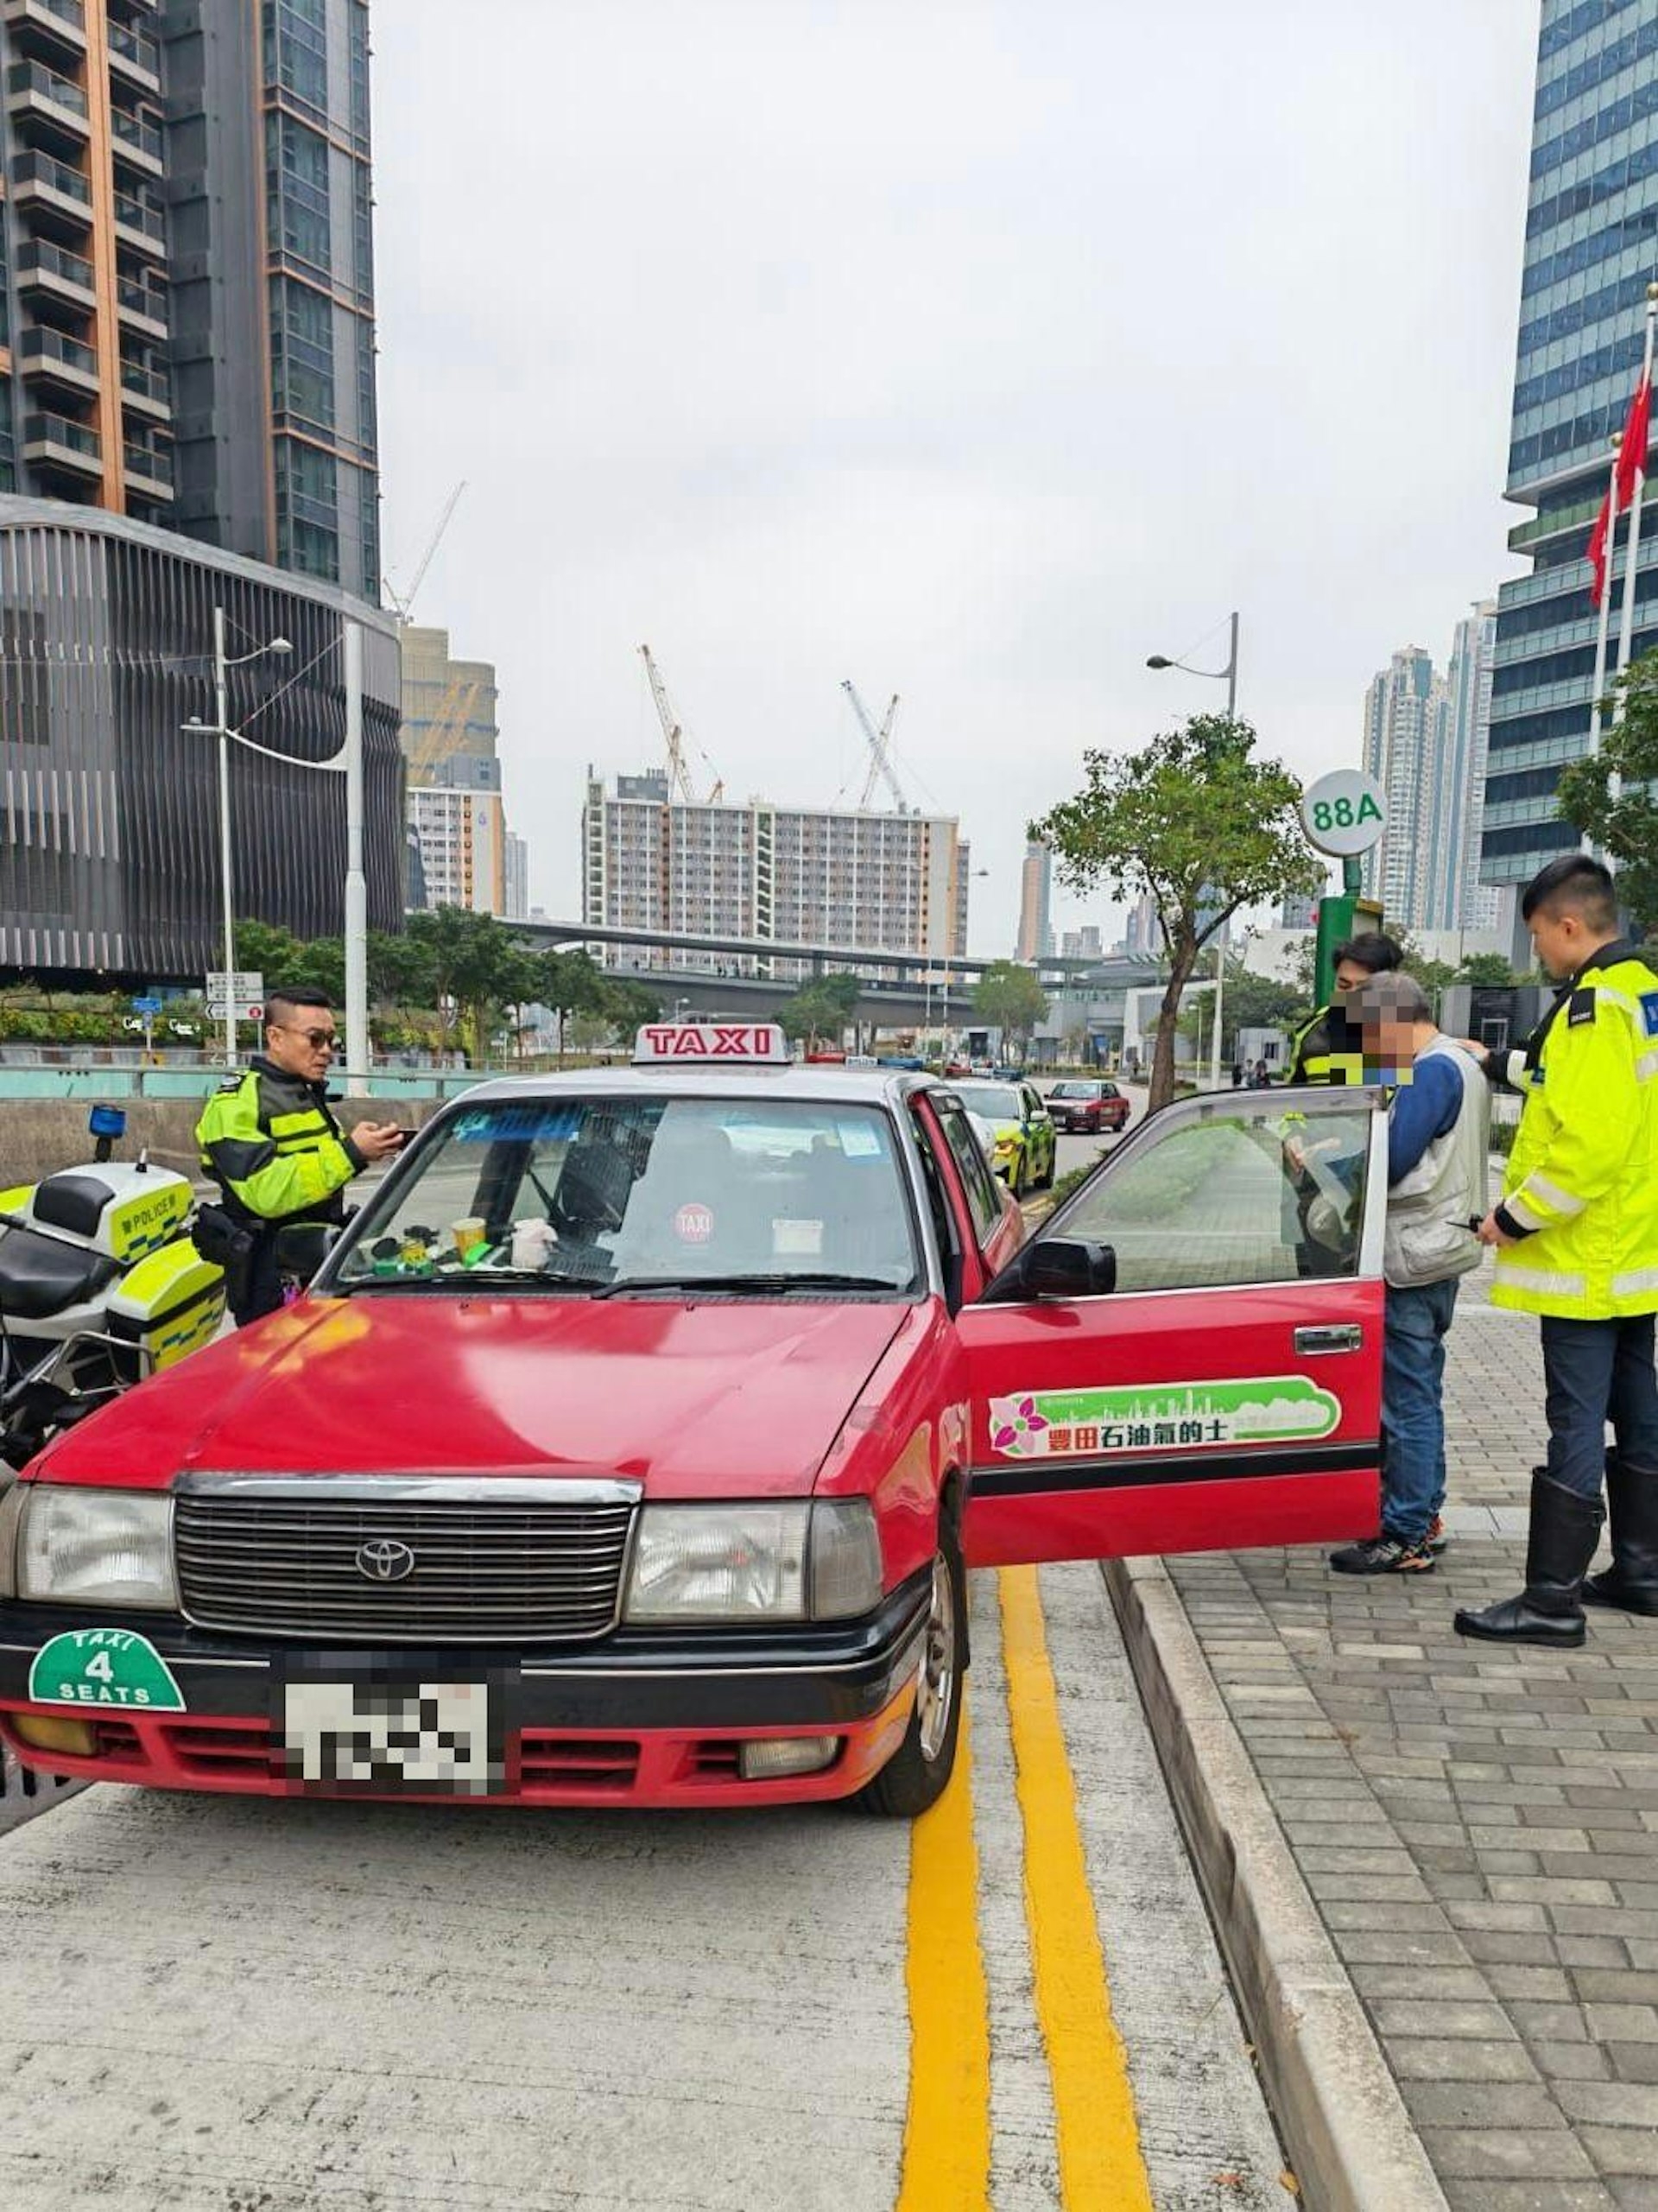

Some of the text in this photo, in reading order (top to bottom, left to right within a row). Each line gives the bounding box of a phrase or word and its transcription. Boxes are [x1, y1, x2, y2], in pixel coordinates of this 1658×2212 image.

[1313, 793, 1383, 831] 88A
[647, 1029, 770, 1055] TAXI
[133, 1196, 168, 1228] POLICE
[680, 1214, 711, 1233] TAXI
[1048, 1419, 1228, 1451] 豐田石油氣的士
[73, 1632, 136, 1651] TAXI
[85, 1651, 114, 1683] 4
[59, 1683, 150, 1703] SEATS
